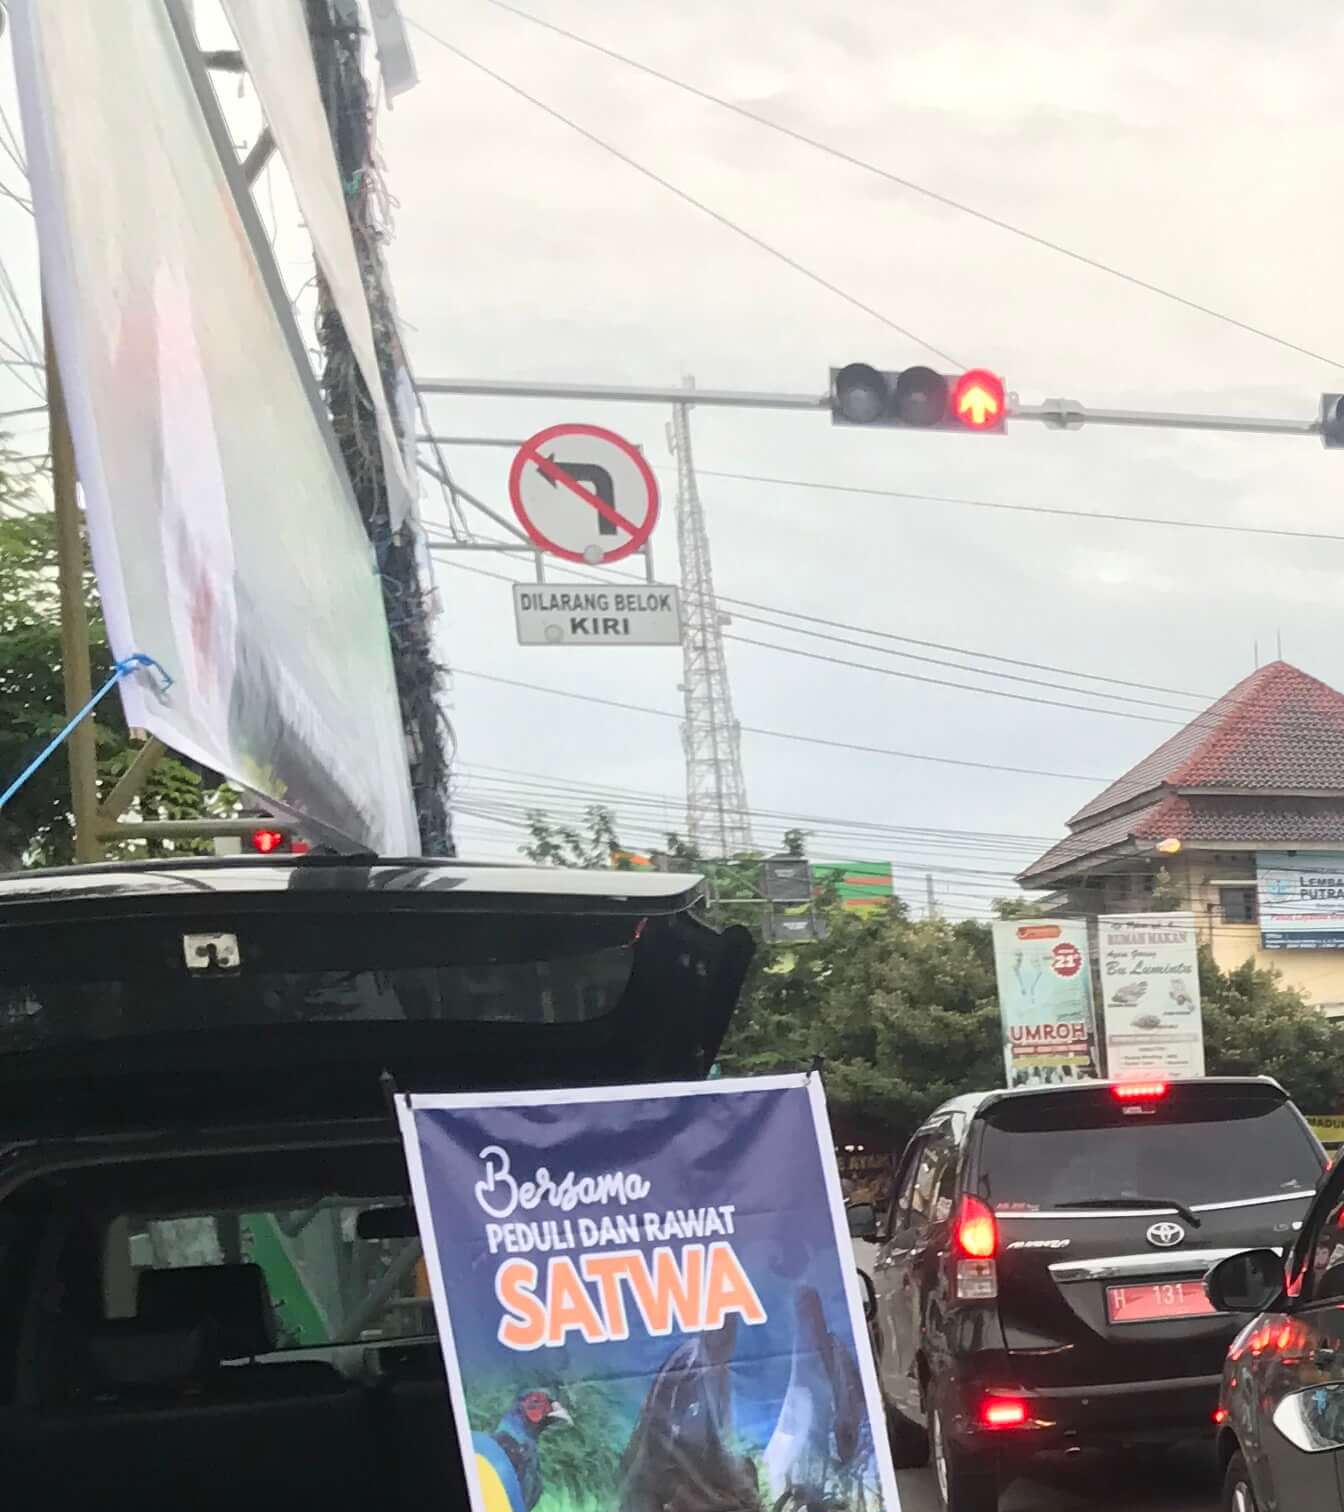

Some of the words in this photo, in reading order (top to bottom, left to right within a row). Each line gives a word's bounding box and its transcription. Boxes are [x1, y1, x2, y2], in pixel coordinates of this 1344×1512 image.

[520, 592, 609, 614] DILARANG
[613, 592, 672, 614] BELOK
[570, 616, 630, 637] KIRI
[1010, 1023, 1086, 1042] UMROH
[475, 1145, 651, 1219] Bersama
[485, 1218, 577, 1255] PEDULI
[580, 1211, 641, 1246] DAN
[645, 1205, 737, 1242] RAWAT
[495, 1241, 767, 1350] SATWA
[1112, 1288, 1127, 1310] H
